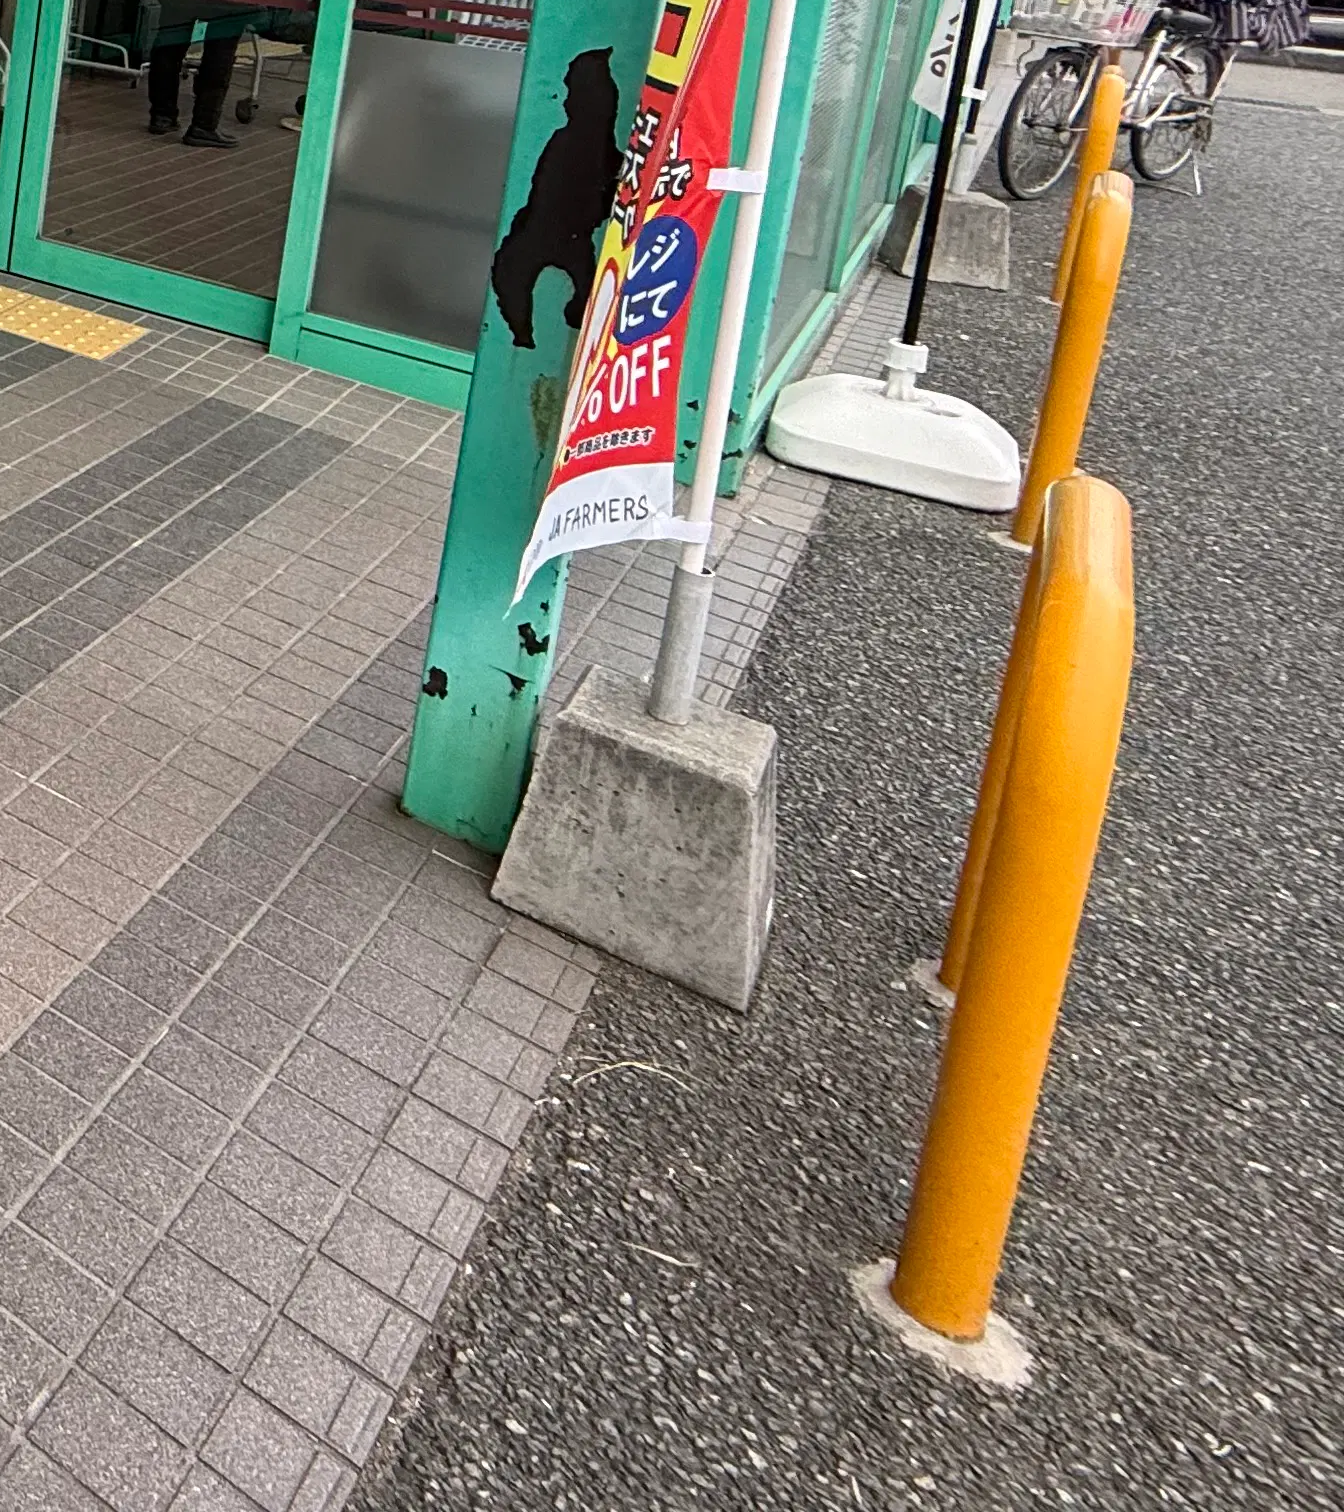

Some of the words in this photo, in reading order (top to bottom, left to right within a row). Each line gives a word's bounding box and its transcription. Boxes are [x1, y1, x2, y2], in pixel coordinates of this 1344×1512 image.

[625, 227, 683, 280] レジ
[619, 279, 679, 334] にて
[563, 494, 650, 535] FARMERS
